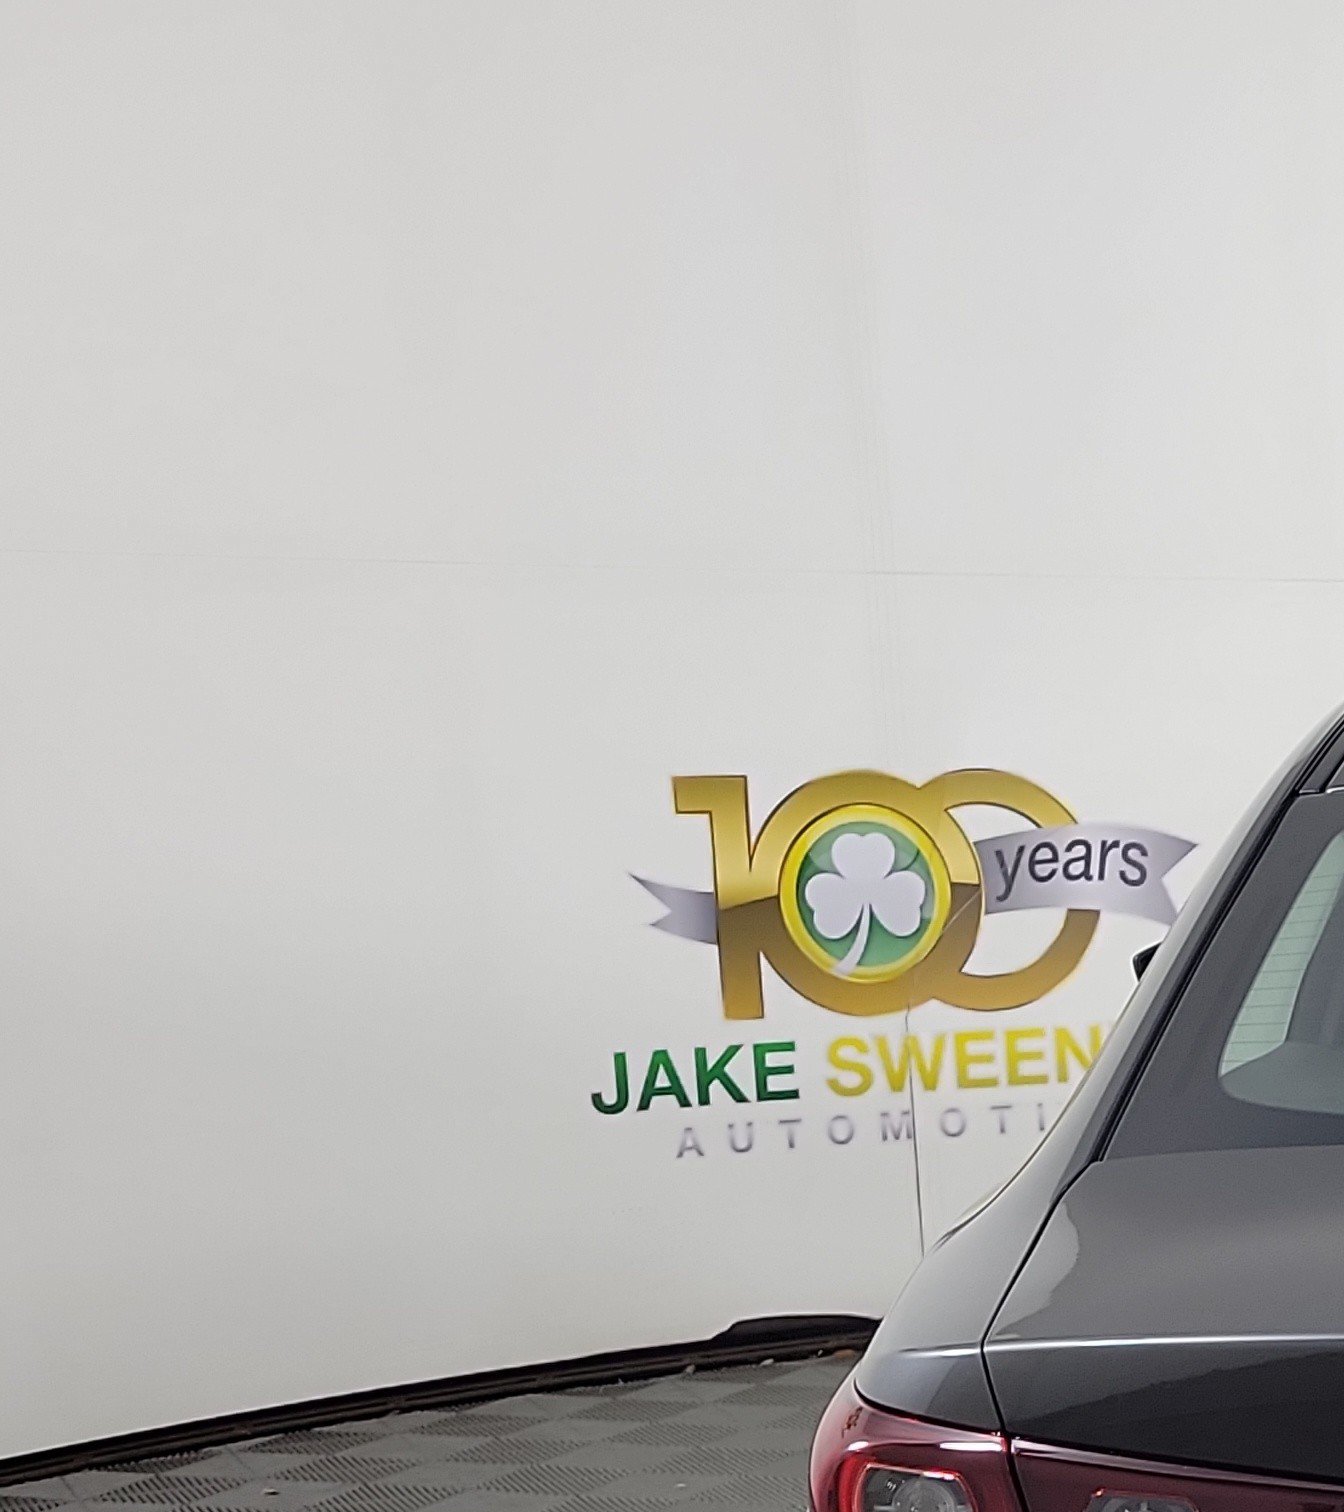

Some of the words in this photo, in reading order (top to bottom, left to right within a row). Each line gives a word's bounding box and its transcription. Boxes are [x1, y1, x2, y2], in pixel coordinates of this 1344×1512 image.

[671, 768, 1100, 1020] 100
[994, 837, 1150, 901] years
[590, 1040, 801, 1116] JAKE
[825, 1024, 1104, 1098] SWEEN
[676, 1102, 1046, 1160] AUTOMOTI
